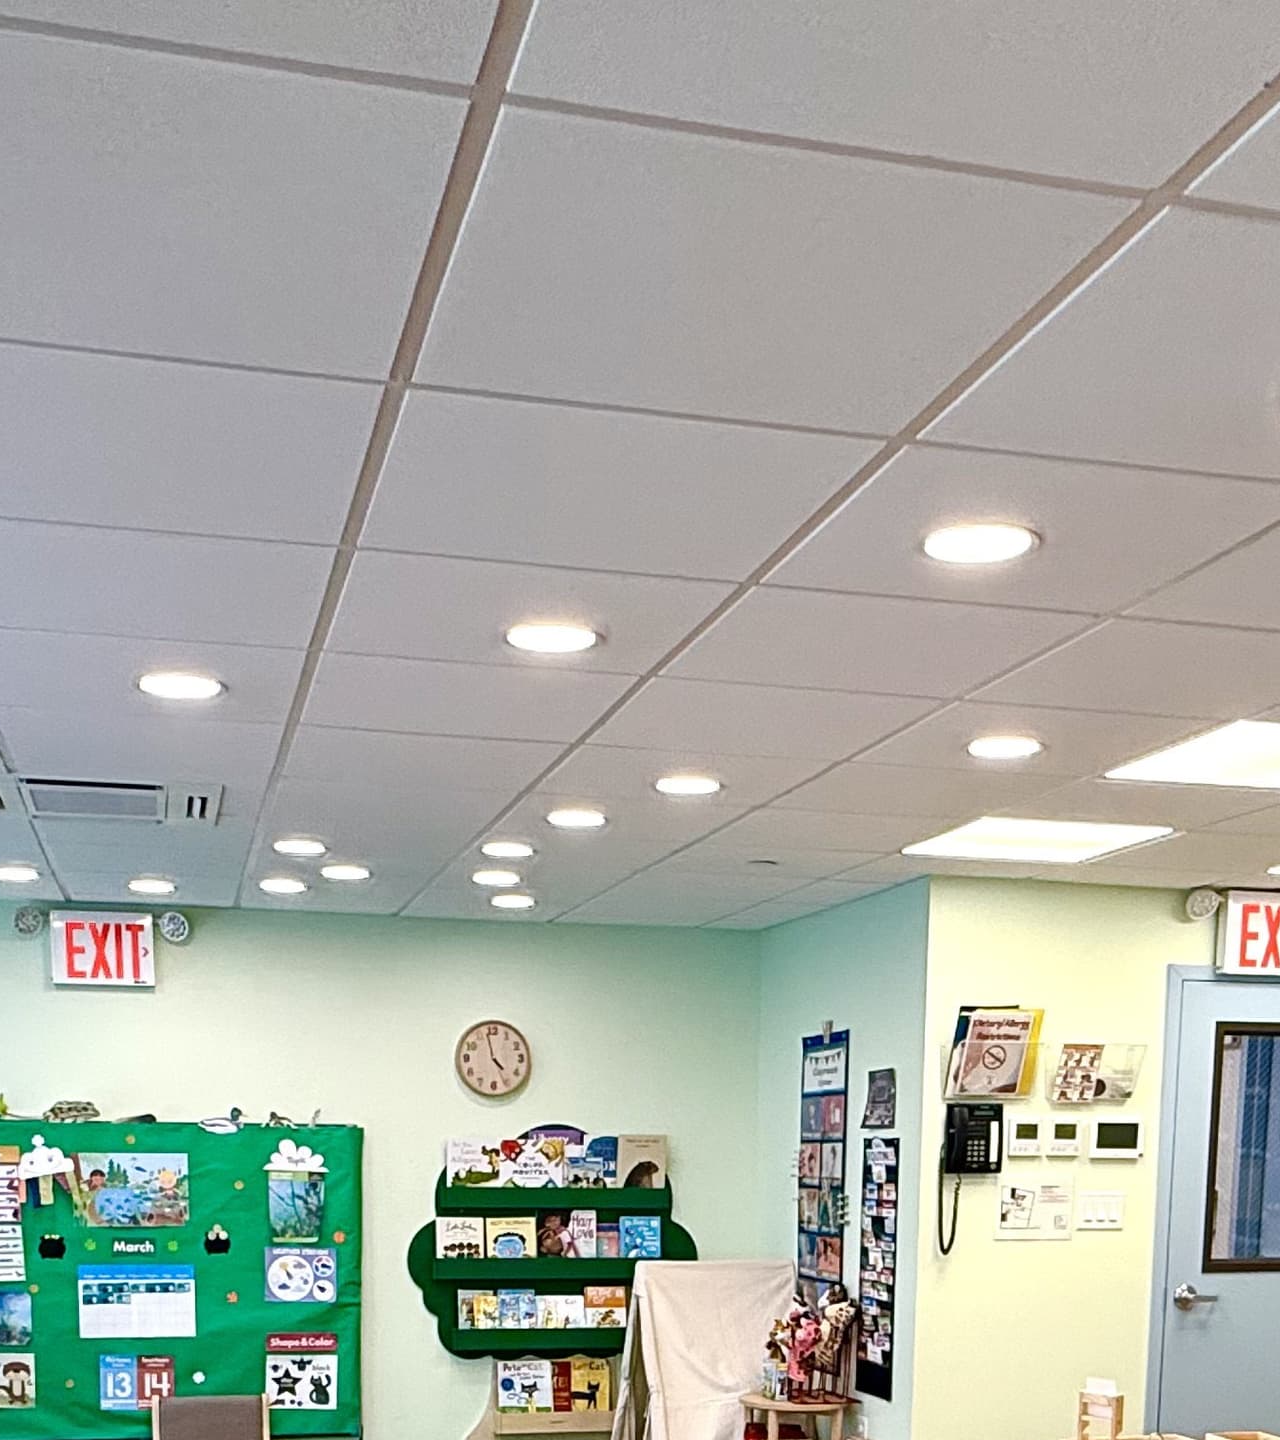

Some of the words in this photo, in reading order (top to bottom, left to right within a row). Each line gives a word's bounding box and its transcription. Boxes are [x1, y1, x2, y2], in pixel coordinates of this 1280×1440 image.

[65, 922, 144, 979] EXIT
[487, 1026, 498, 1036] 12
[517, 1053, 524, 1064] 3
[113, 1240, 154, 1253] March
[270, 1336, 299, 1349] Shape
[300, 1337, 307, 1347] &
[308, 1336, 335, 1347] Color
[106, 1371, 132, 1398] 13
[144, 1371, 171, 1398] 14
